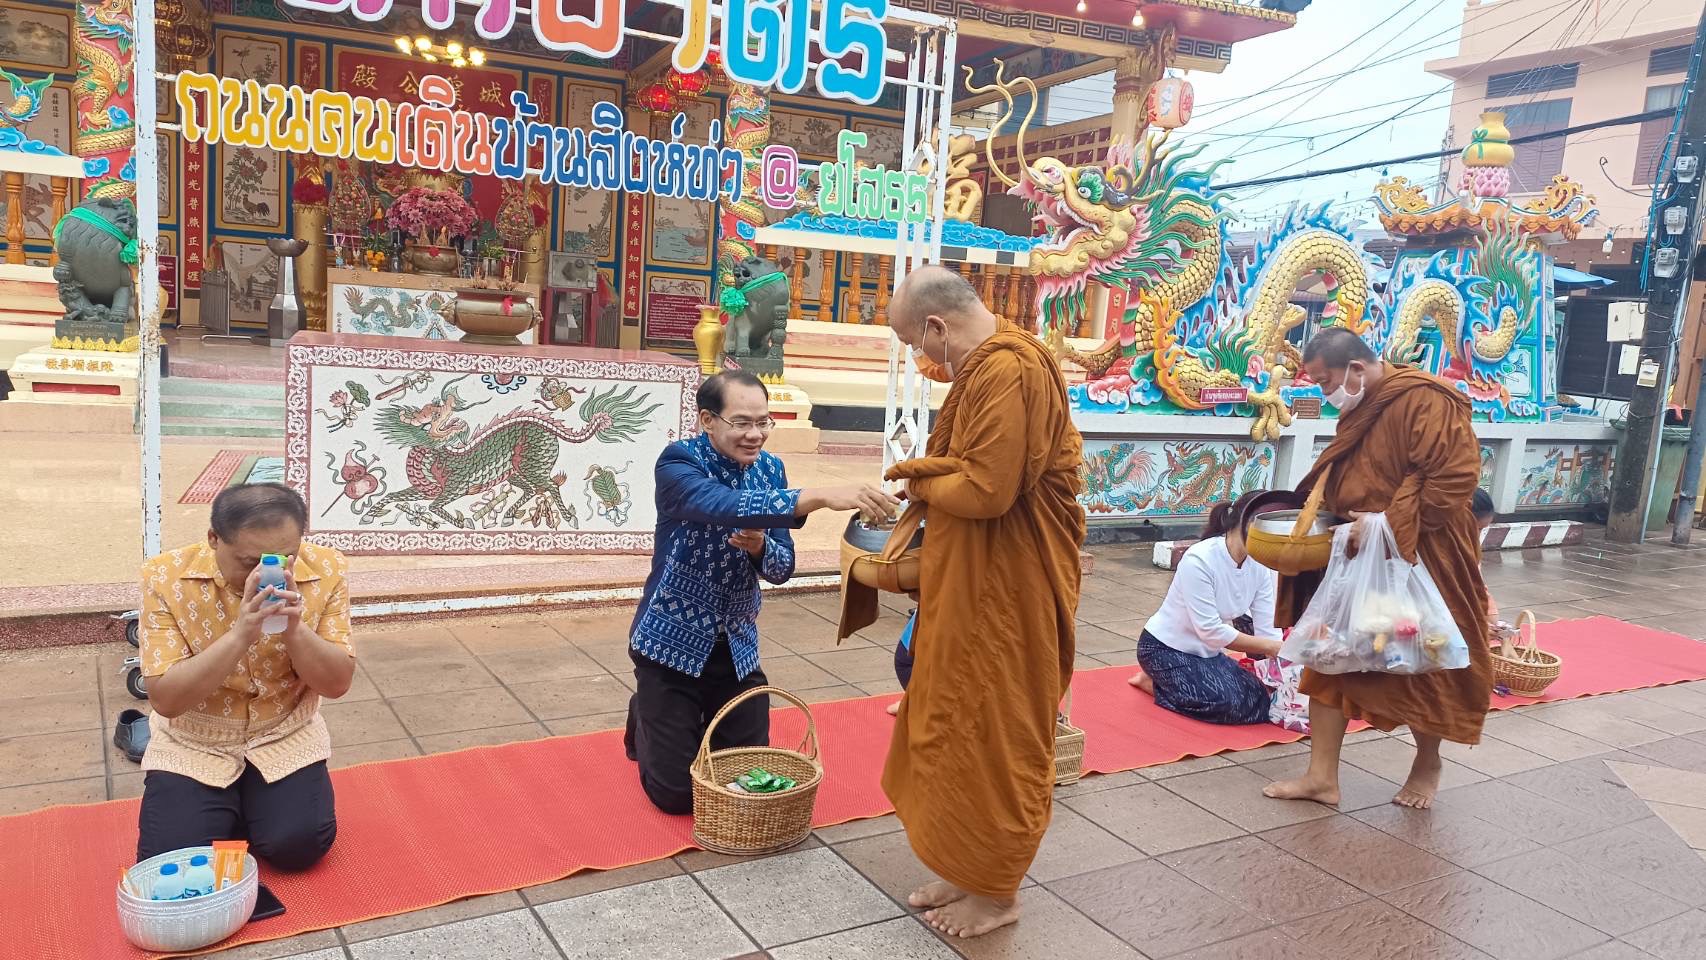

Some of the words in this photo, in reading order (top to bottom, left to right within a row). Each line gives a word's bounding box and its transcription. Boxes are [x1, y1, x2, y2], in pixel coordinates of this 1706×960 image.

[177, 70, 743, 202] ถนนคนเดินบ้านสิงห์ท่า
[762, 145, 798, 209] @
[819, 129, 928, 223] ยโสธร
